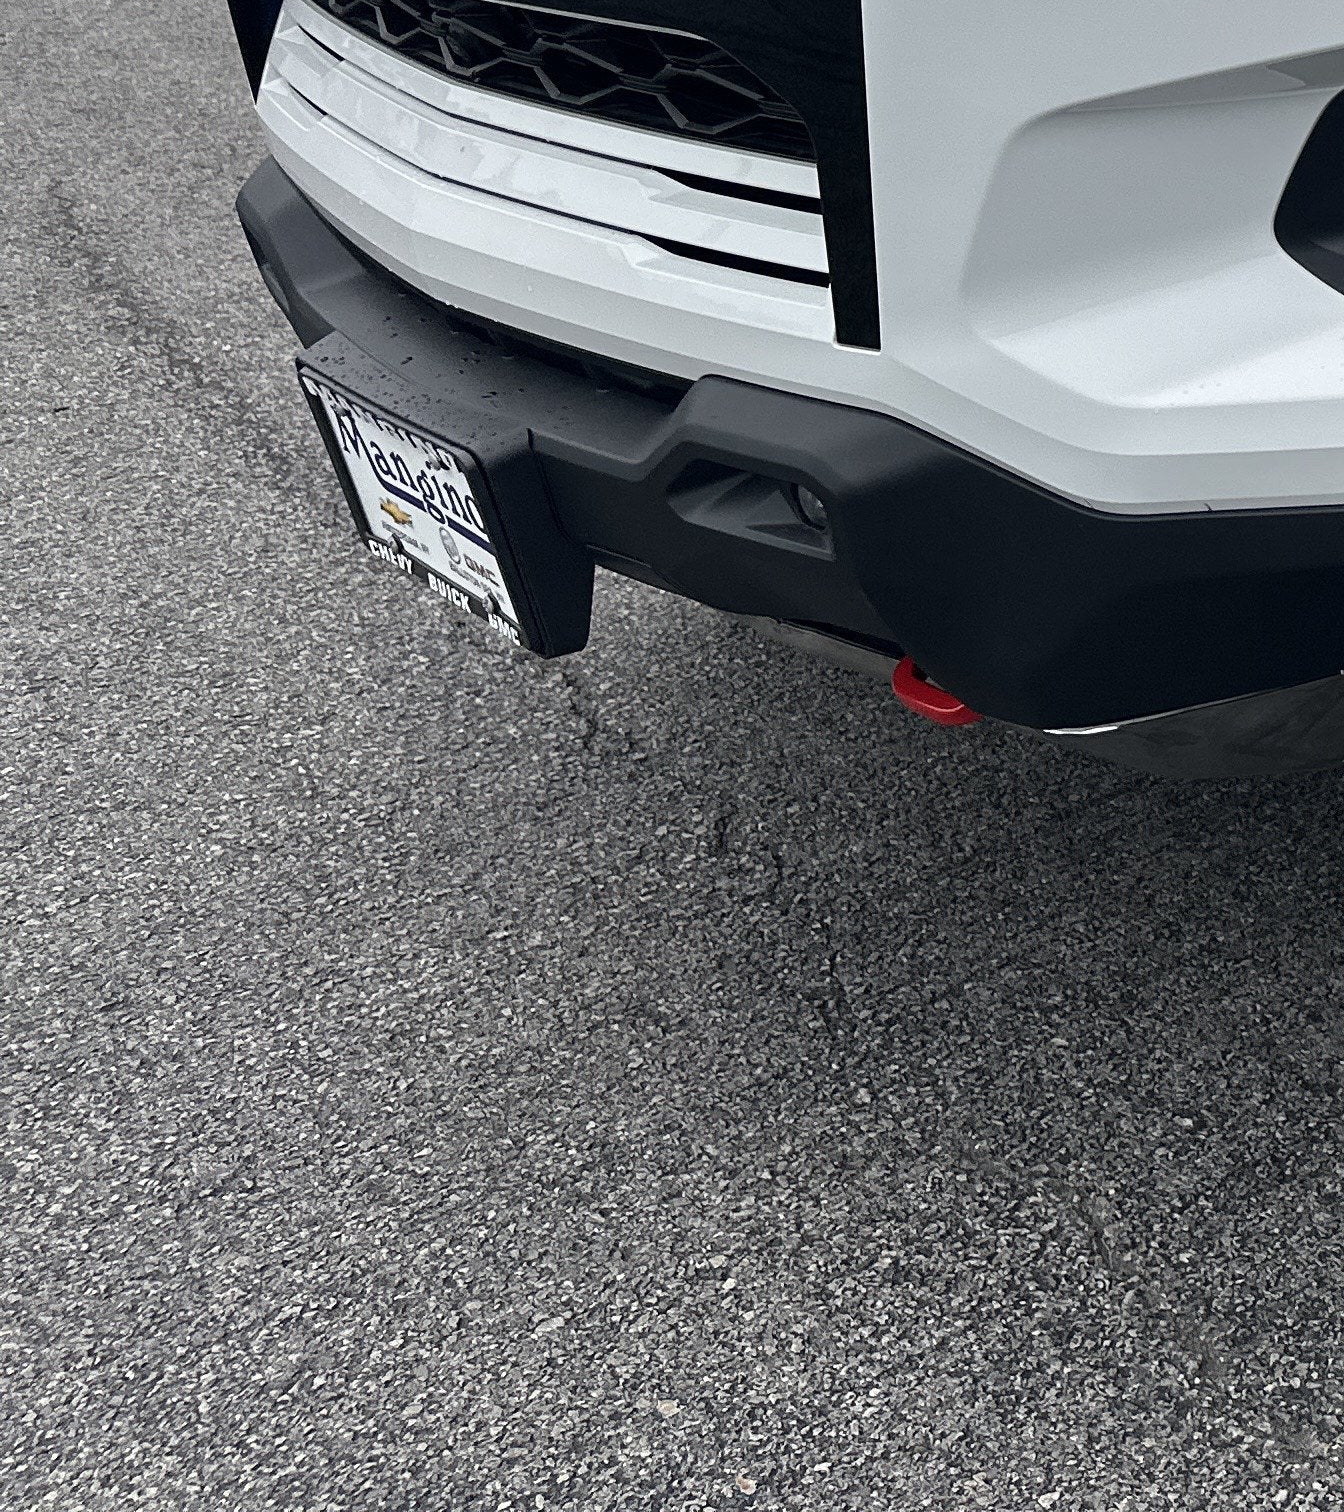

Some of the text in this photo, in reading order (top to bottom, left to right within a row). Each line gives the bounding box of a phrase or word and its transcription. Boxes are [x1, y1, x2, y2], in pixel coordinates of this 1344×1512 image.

[333, 405, 487, 530] Mangino
[368, 539, 413, 575] CHEVY
[428, 572, 472, 614] BUICK
[488, 613, 522, 646] GMC
